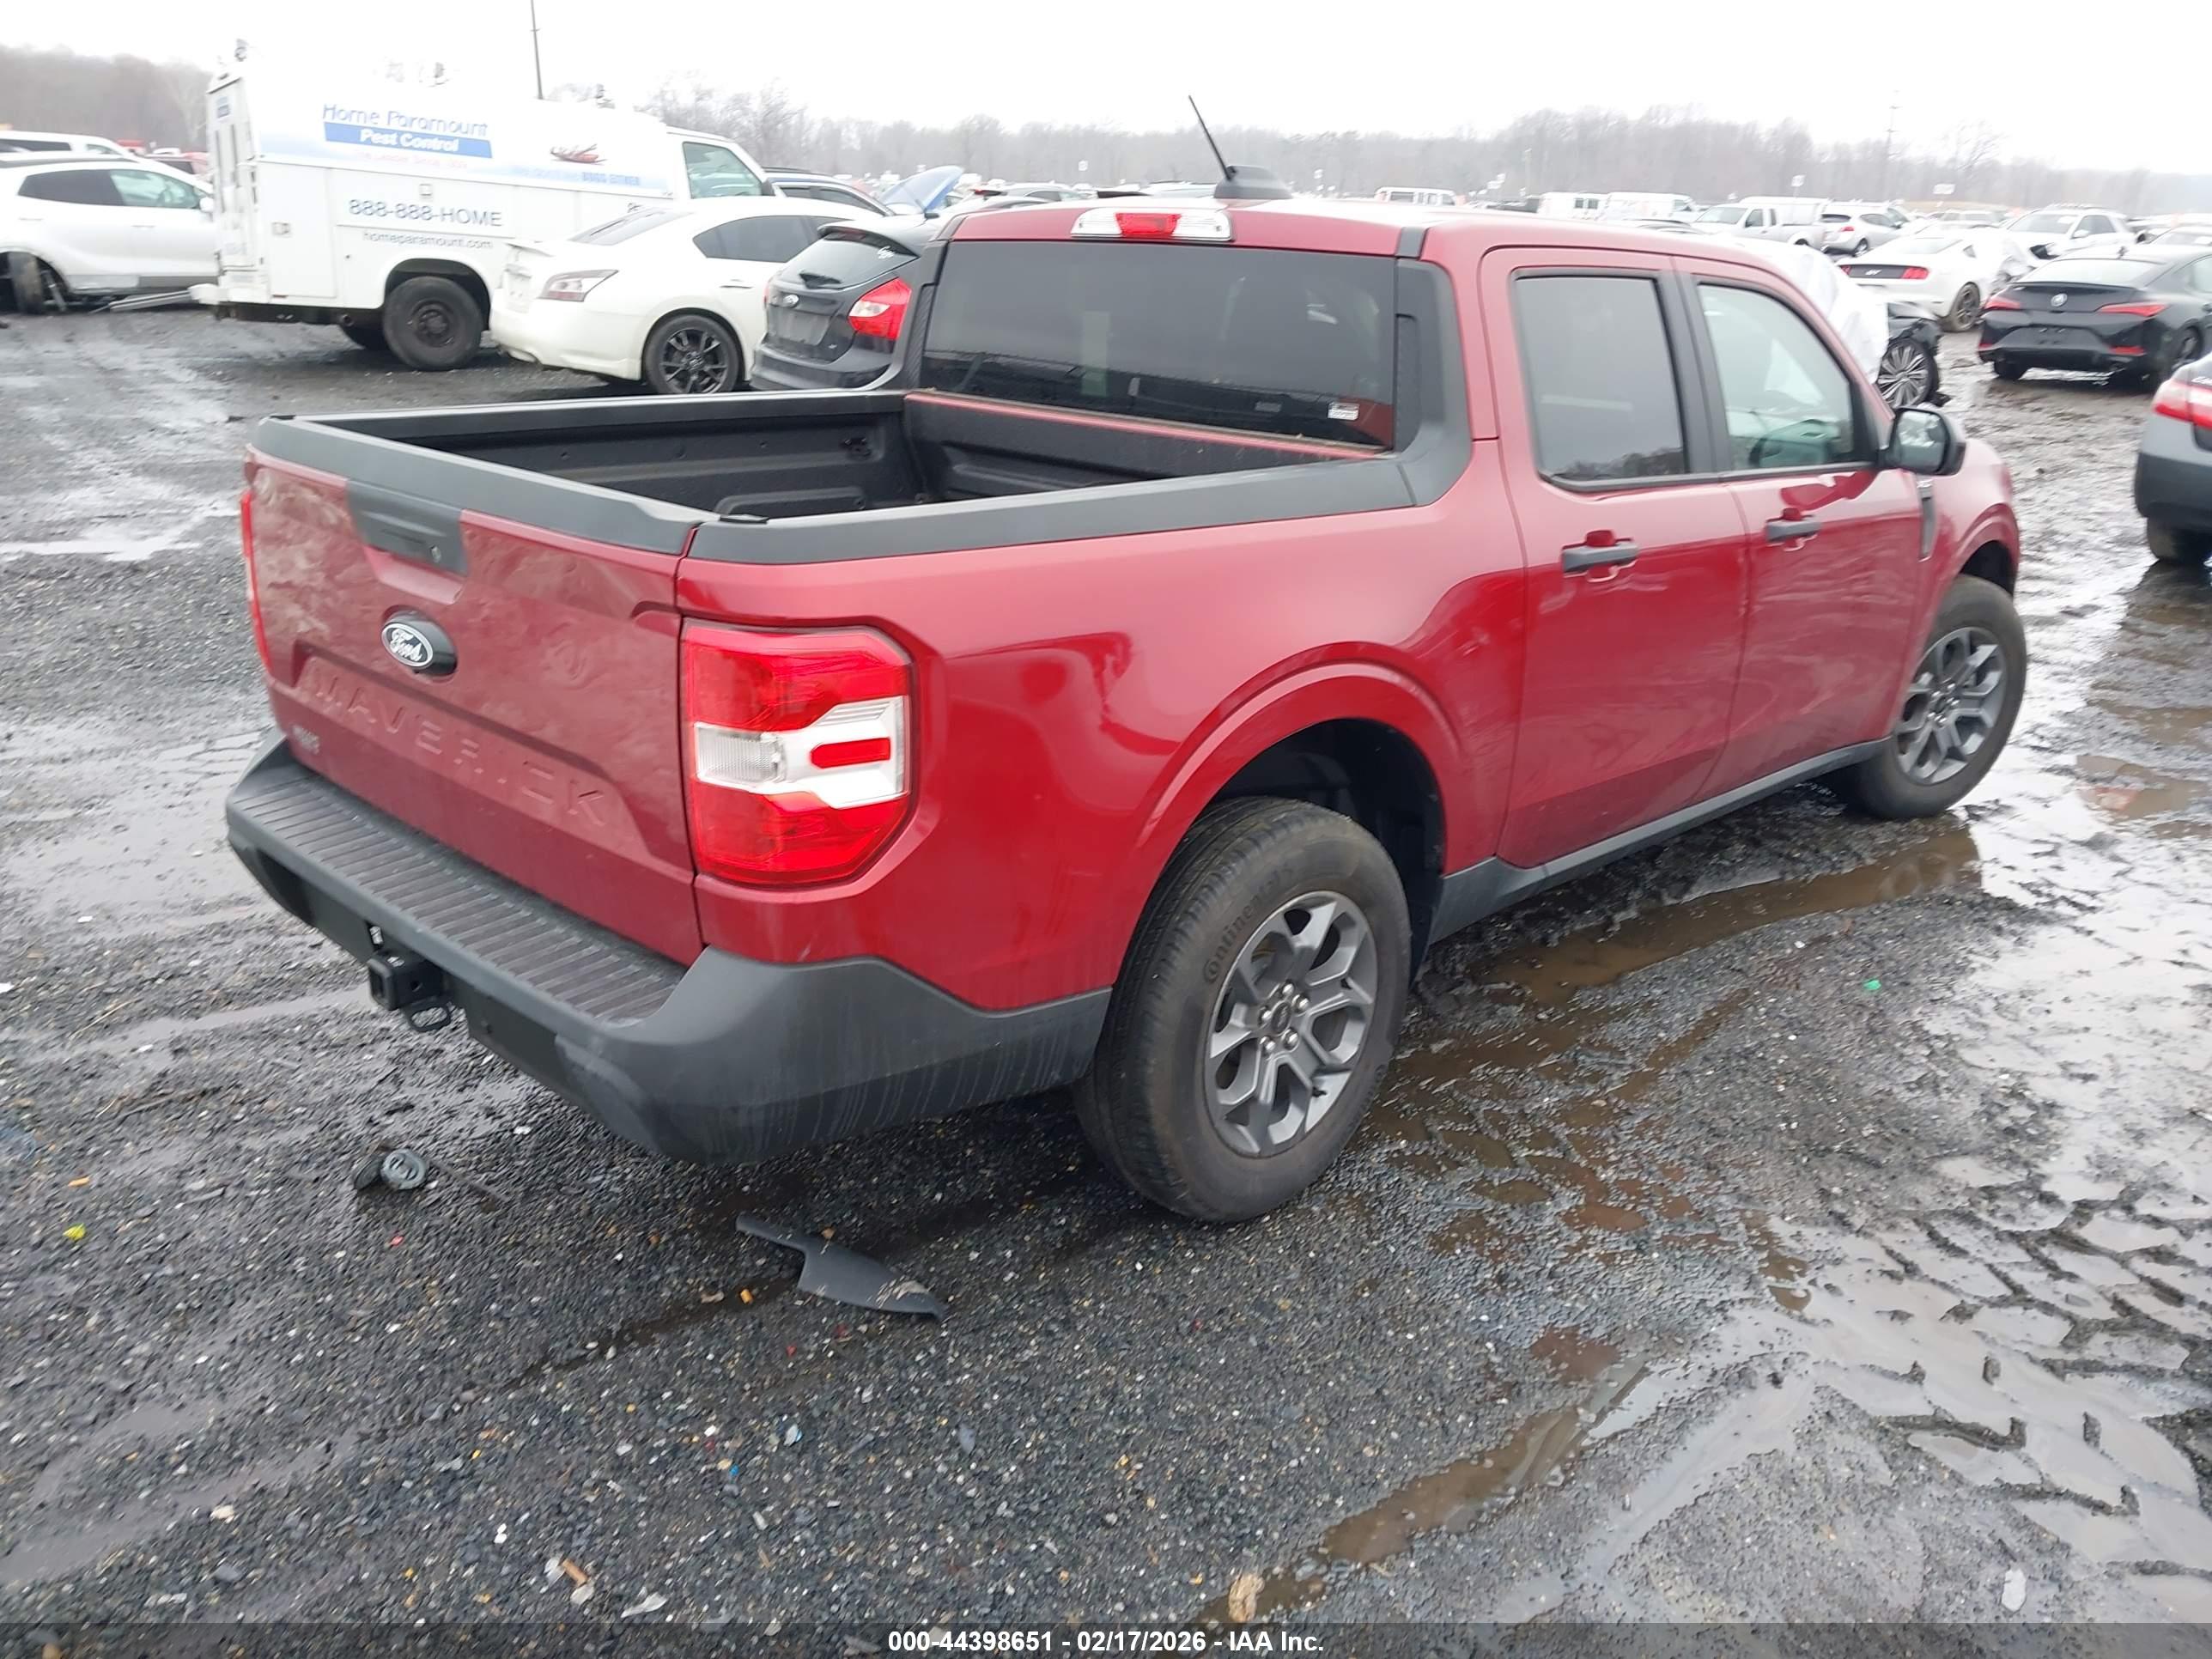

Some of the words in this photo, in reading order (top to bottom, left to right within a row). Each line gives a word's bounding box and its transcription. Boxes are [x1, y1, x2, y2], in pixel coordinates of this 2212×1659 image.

[323, 103, 380, 125] Home
[387, 110, 489, 137] Paramount
[360, 128, 398, 146] Pest
[400, 132, 459, 152] Control
[349, 198, 503, 228] 888-888-HOME
[364, 230, 495, 249] homeparamount.com
